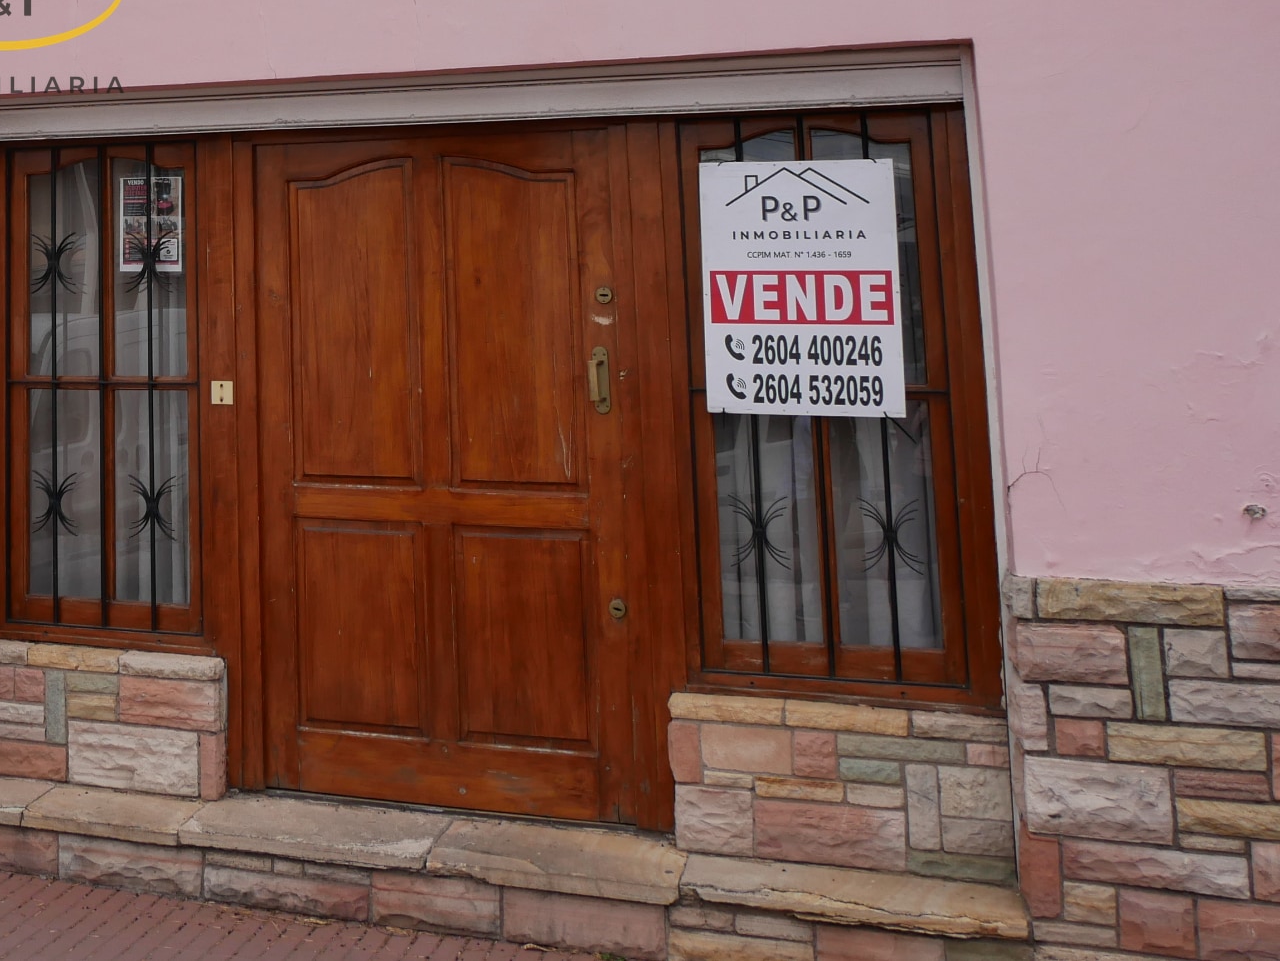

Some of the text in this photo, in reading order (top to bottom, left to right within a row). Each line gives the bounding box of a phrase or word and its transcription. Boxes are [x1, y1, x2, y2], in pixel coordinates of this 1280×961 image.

[761, 195, 822, 222] P&P
[732, 230, 867, 240] INMOBILIARIA
[747, 251, 771, 259] CCPIM
[806, 251, 826, 259] 1.436
[715, 274, 888, 321] VENDE
[752, 334, 883, 367] 2604 400246
[753, 373, 884, 406] 2604 532059
